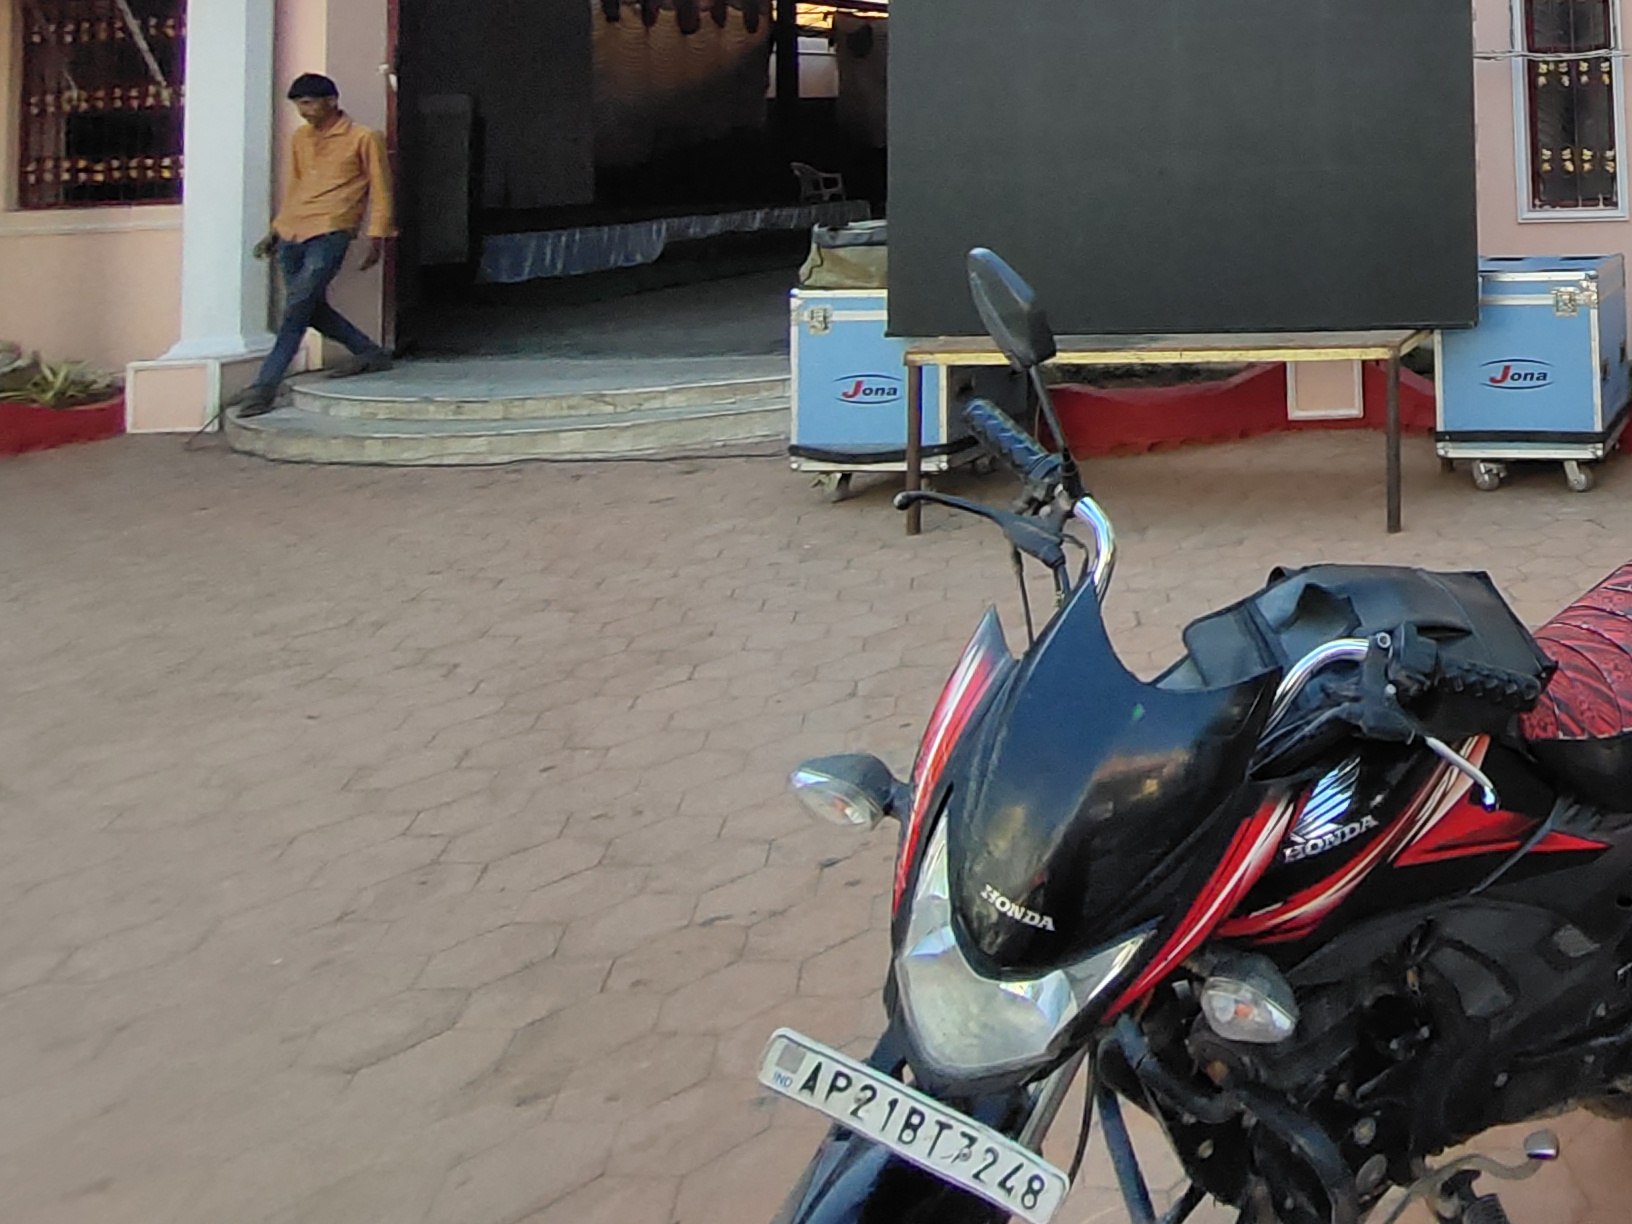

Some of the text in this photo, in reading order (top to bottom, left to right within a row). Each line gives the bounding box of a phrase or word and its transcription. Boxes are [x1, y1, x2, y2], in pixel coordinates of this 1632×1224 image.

[842, 380, 898, 399] Jona
[1489, 365, 1548, 384] Jona
[1283, 814, 1379, 863] HONDA
[980, 883, 1056, 932] HONDA
